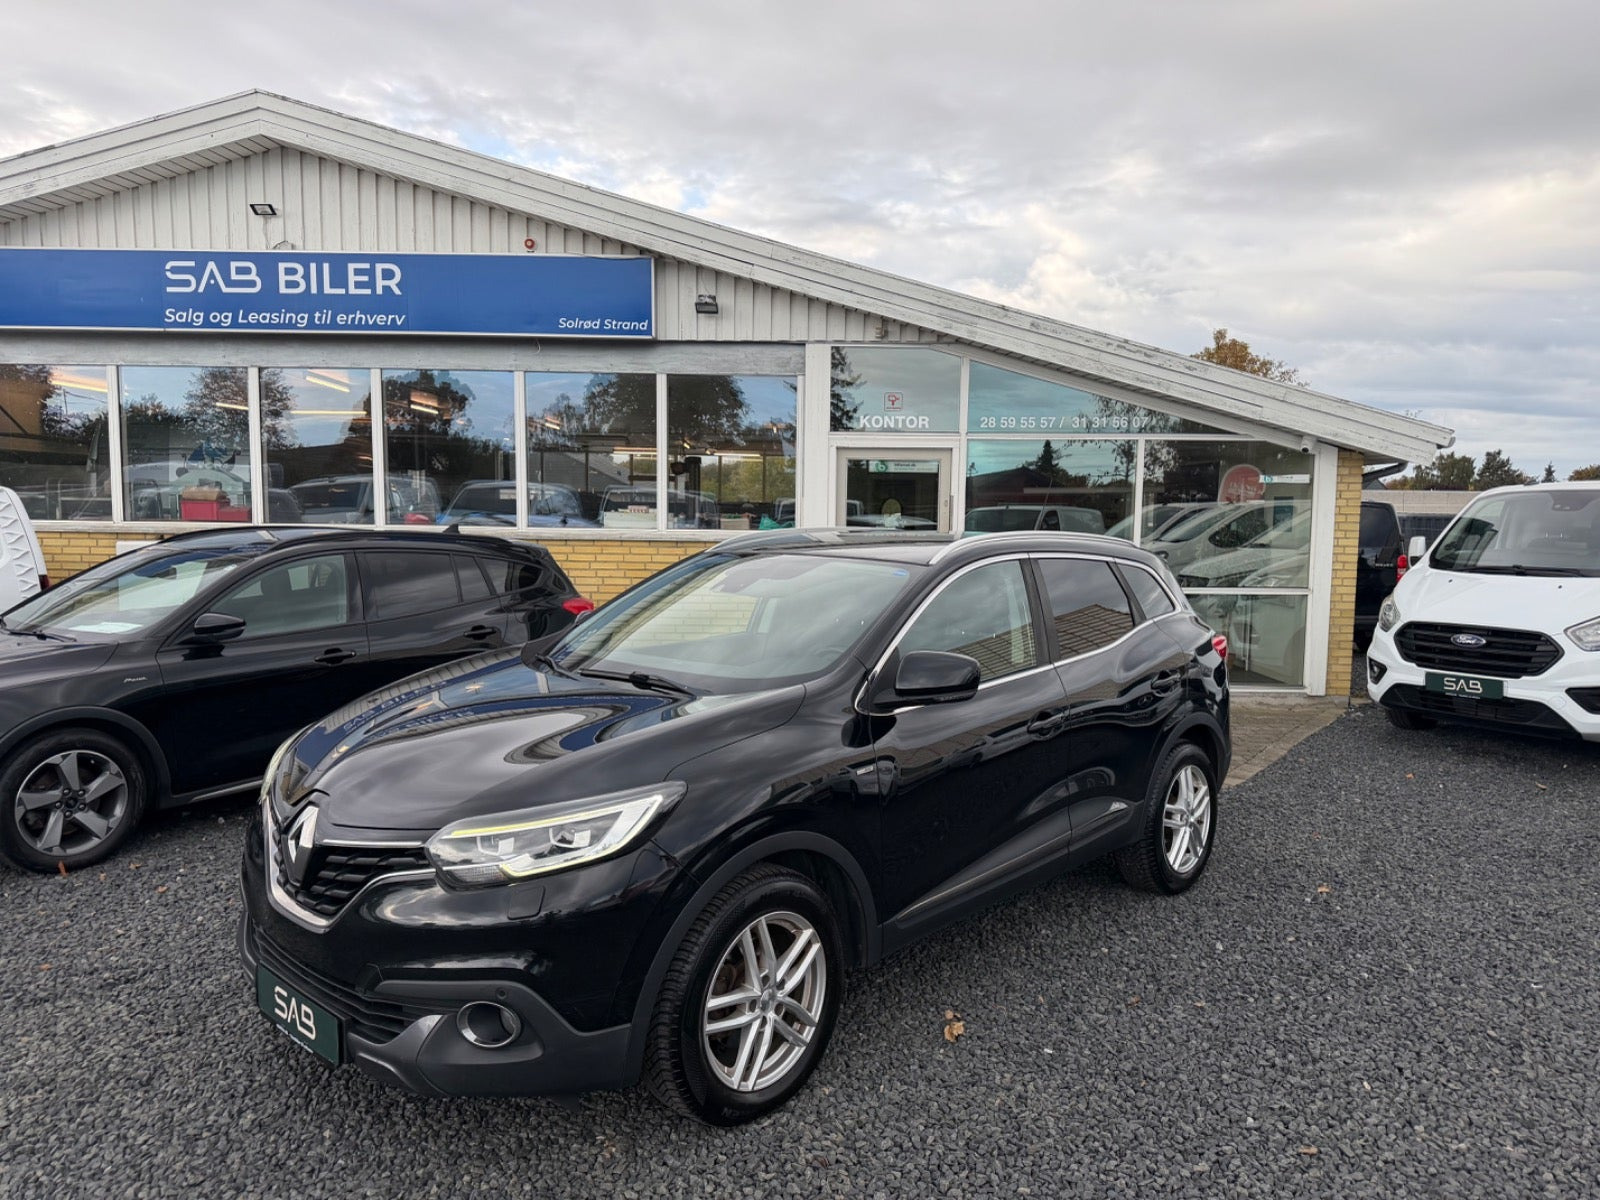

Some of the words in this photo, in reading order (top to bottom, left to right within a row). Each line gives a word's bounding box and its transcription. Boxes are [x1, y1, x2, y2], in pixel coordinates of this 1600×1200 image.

[164, 260, 262, 293] SAB
[277, 262, 402, 295] BILER
[164, 308, 204, 326] Salg
[209, 311, 233, 327] og
[238, 309, 309, 327] Leasing
[313, 310, 332, 325] til
[336, 310, 406, 326] erhverv
[558, 317, 601, 330] Solrød
[603, 318, 648, 331] Strand
[859, 415, 930, 429] KONTOR
[980, 416, 996, 429] 28
[1000, 416, 1016, 429] 59
[1020, 416, 1036, 429] 55
[1040, 416, 1056, 429] 57
[1071, 416, 1087, 429] 31
[1091, 416, 1107, 429] 31
[1132, 416, 1149, 429] 07
[1443, 677, 1483, 693] SAB
[274, 985, 316, 1040] SAB
